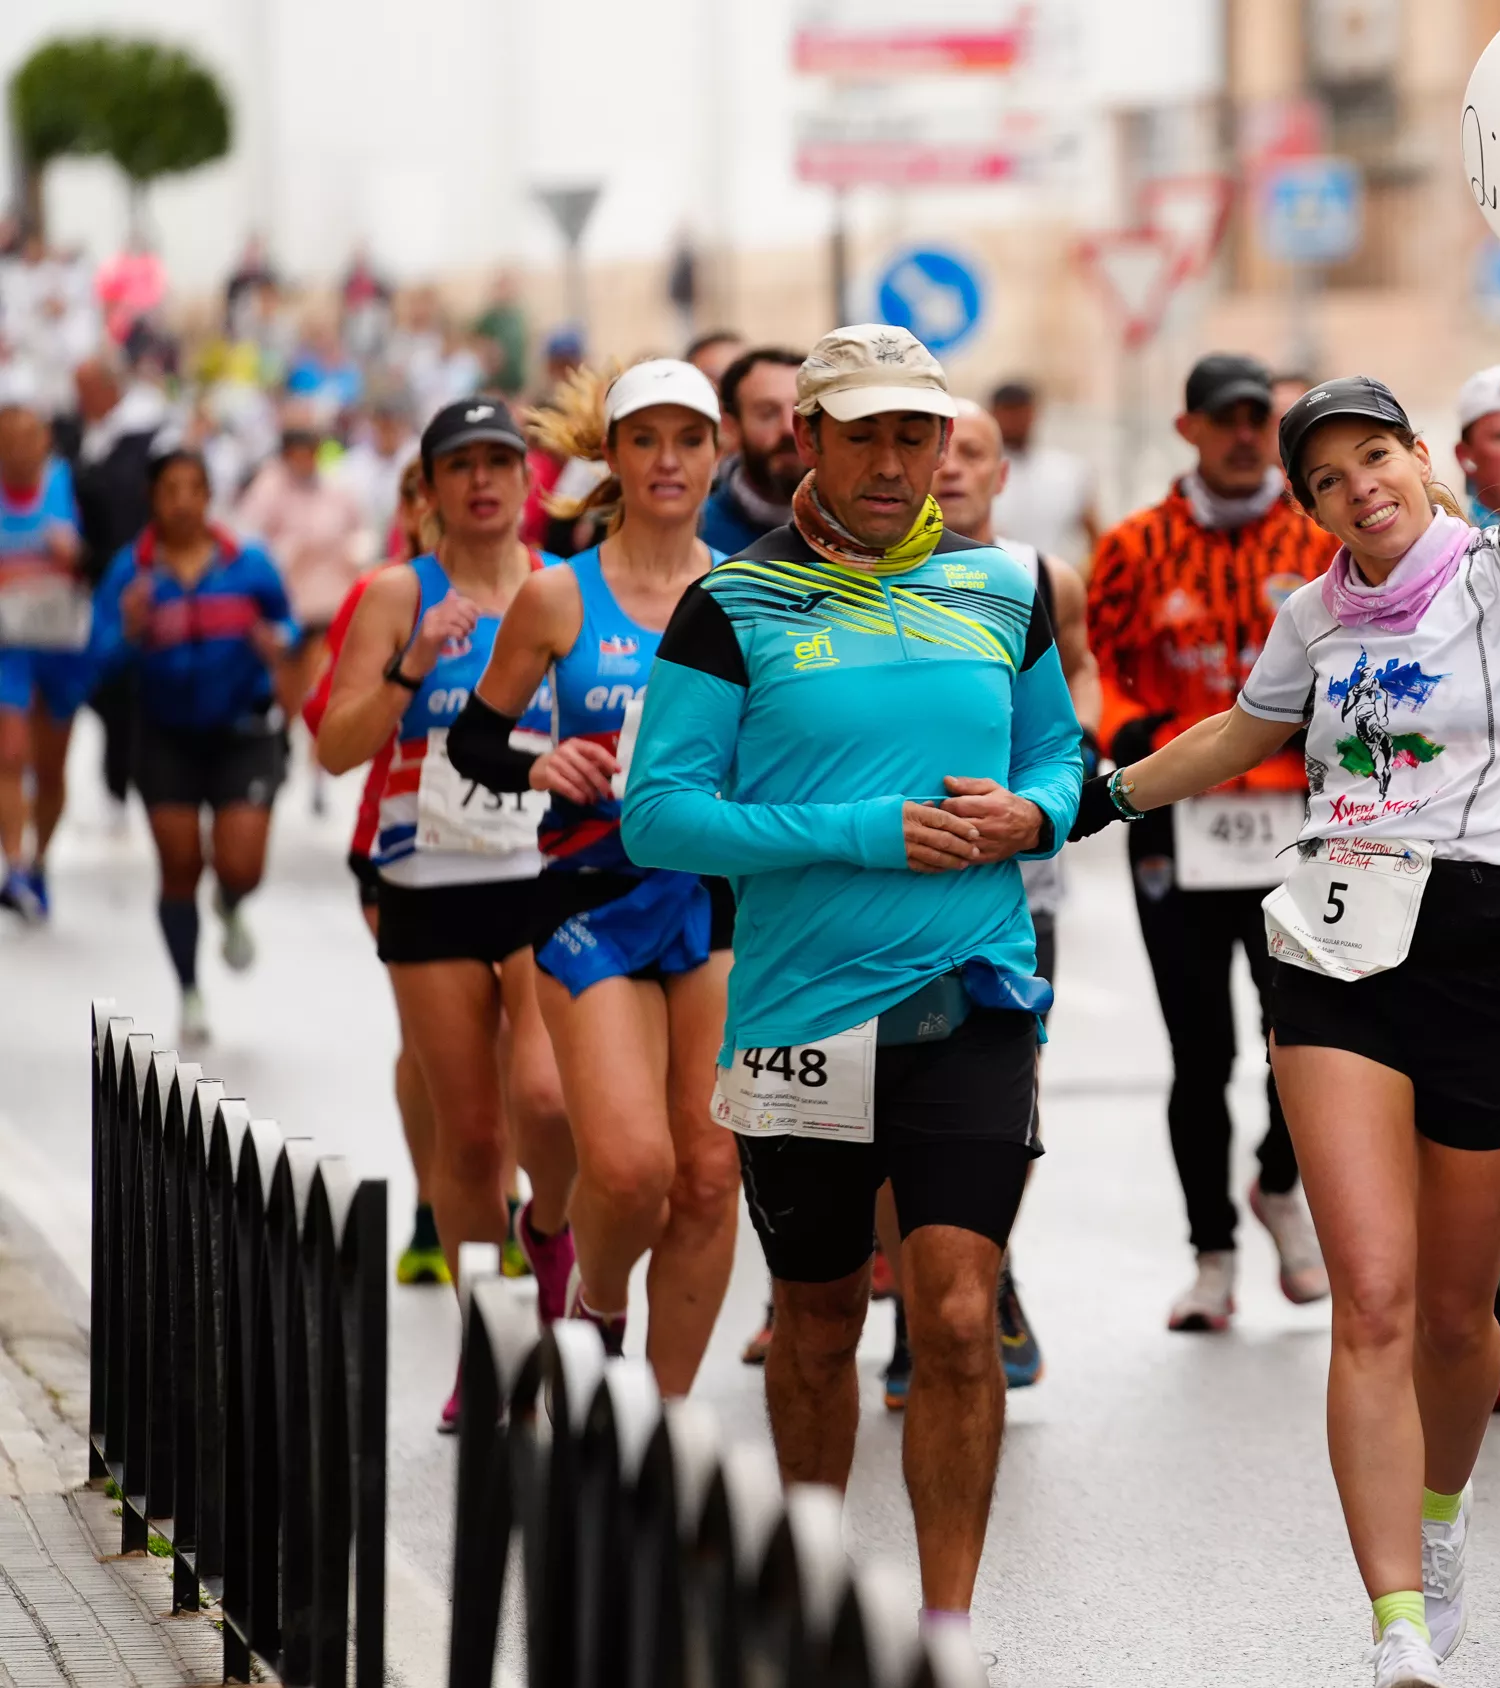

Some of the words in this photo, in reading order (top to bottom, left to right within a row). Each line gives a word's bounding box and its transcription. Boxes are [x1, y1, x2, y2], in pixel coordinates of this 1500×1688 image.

[946, 570, 988, 580] Maratón
[947, 580, 985, 589] Lucena
[1209, 811, 1273, 845] 491
[1323, 881, 1348, 924] 5
[742, 1046, 828, 1088] 448
